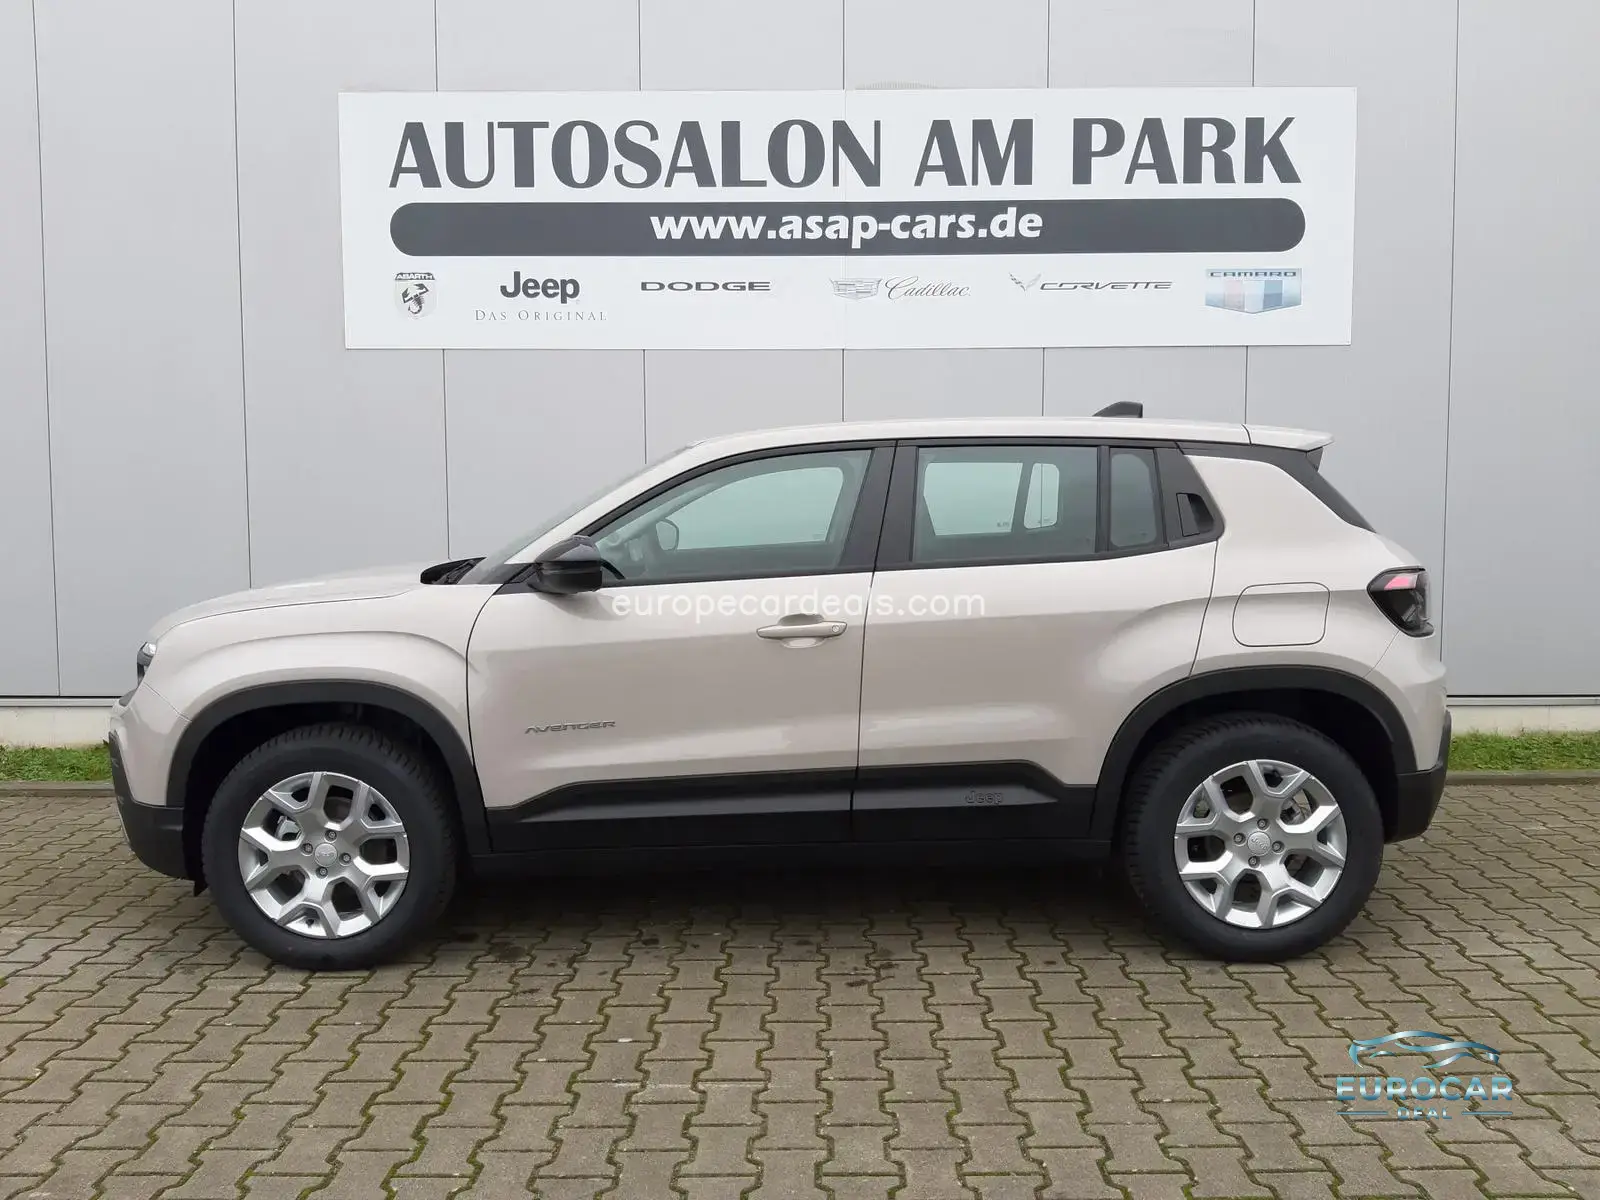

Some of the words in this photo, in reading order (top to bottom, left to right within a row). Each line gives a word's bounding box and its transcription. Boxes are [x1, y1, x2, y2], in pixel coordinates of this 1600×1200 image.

[389, 119, 881, 188] AUTOSALON
[914, 119, 1033, 187] AM
[1072, 116, 1302, 185] PARK
[650, 205, 1043, 249] www.asap-cars.de
[396, 272, 433, 281] ABARTH
[640, 281, 771, 292] DODGE
[1039, 281, 1173, 291] CORVETTE
[500, 271, 580, 304] Jeep
[884, 275, 970, 302] Cadillac
[964, 790, 1004, 805] Jeep
